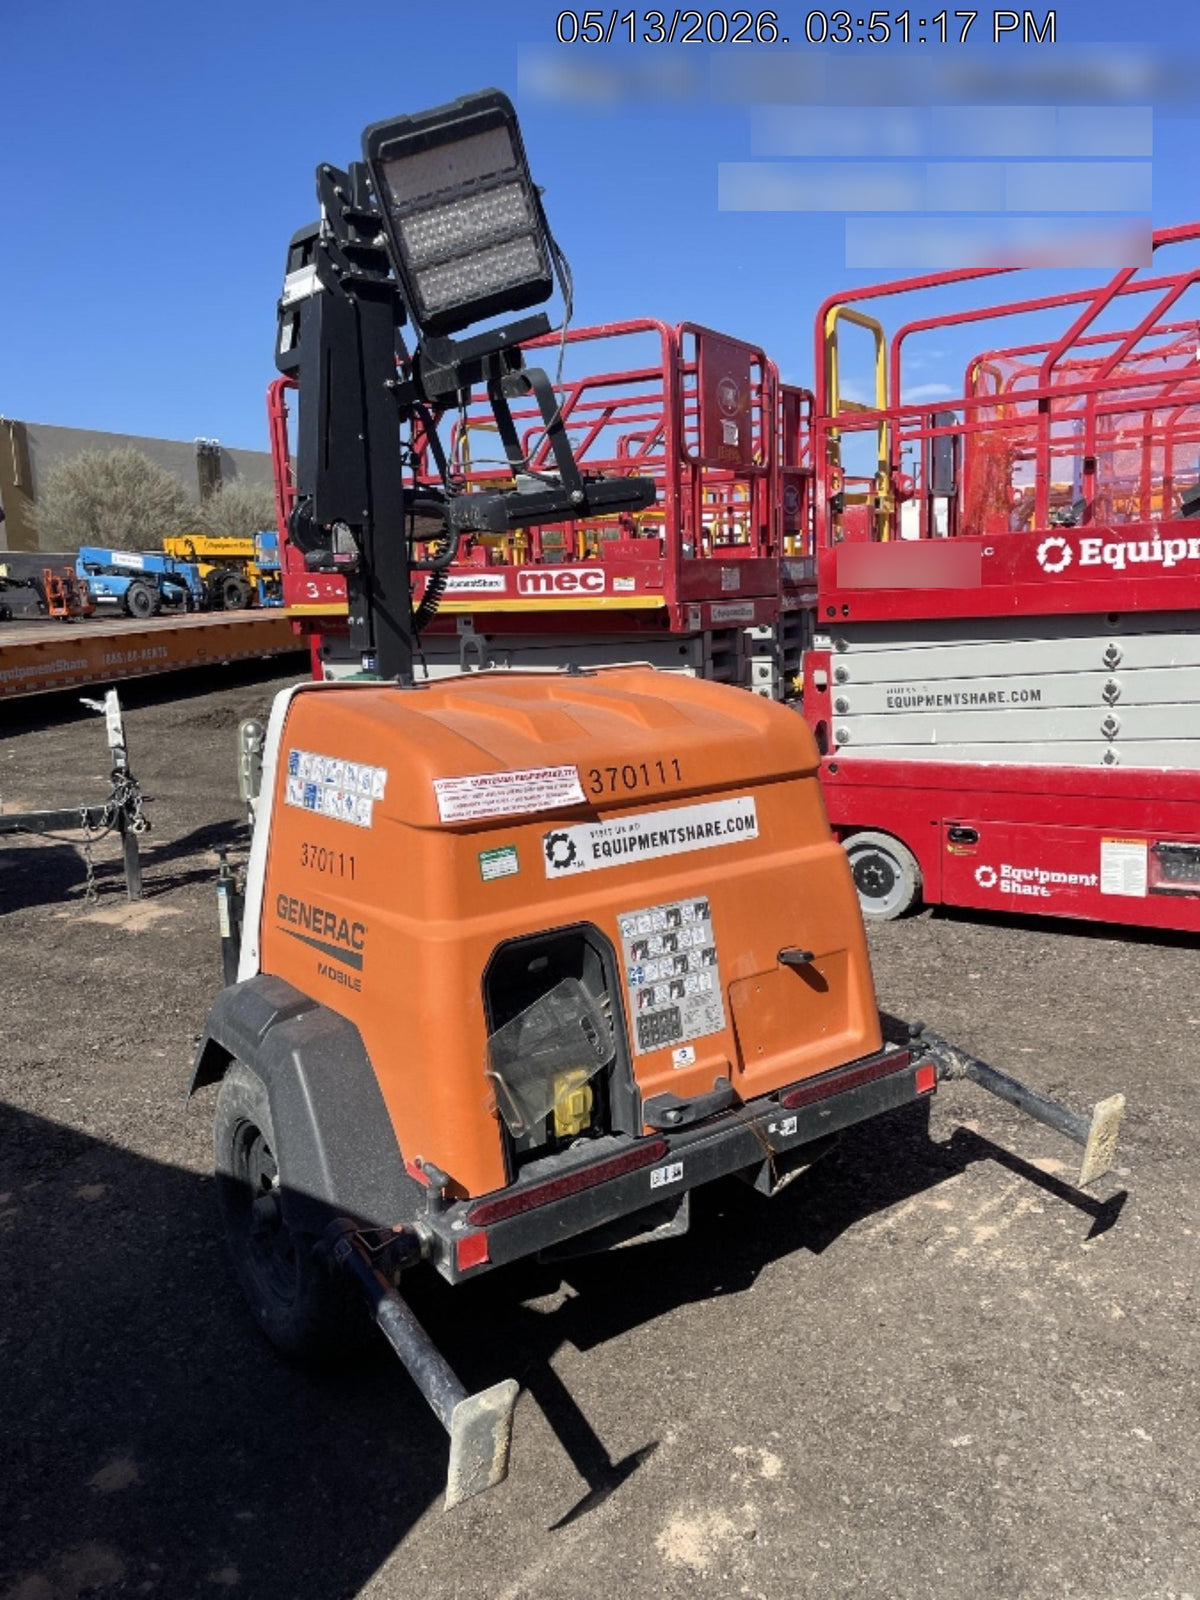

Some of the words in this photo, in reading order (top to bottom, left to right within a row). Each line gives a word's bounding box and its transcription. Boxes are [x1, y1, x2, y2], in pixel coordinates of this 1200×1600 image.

[518, 571, 604, 593] mec
[886, 689, 1042, 708] EQUIPMENTSHARE.COM
[588, 758, 682, 794] 370111
[591, 814, 756, 860] EQUIPMENTSHARE.COM
[300, 842, 356, 881] 370111
[276, 893, 366, 951] GENERAC
[317, 961, 363, 993] MOBILE
